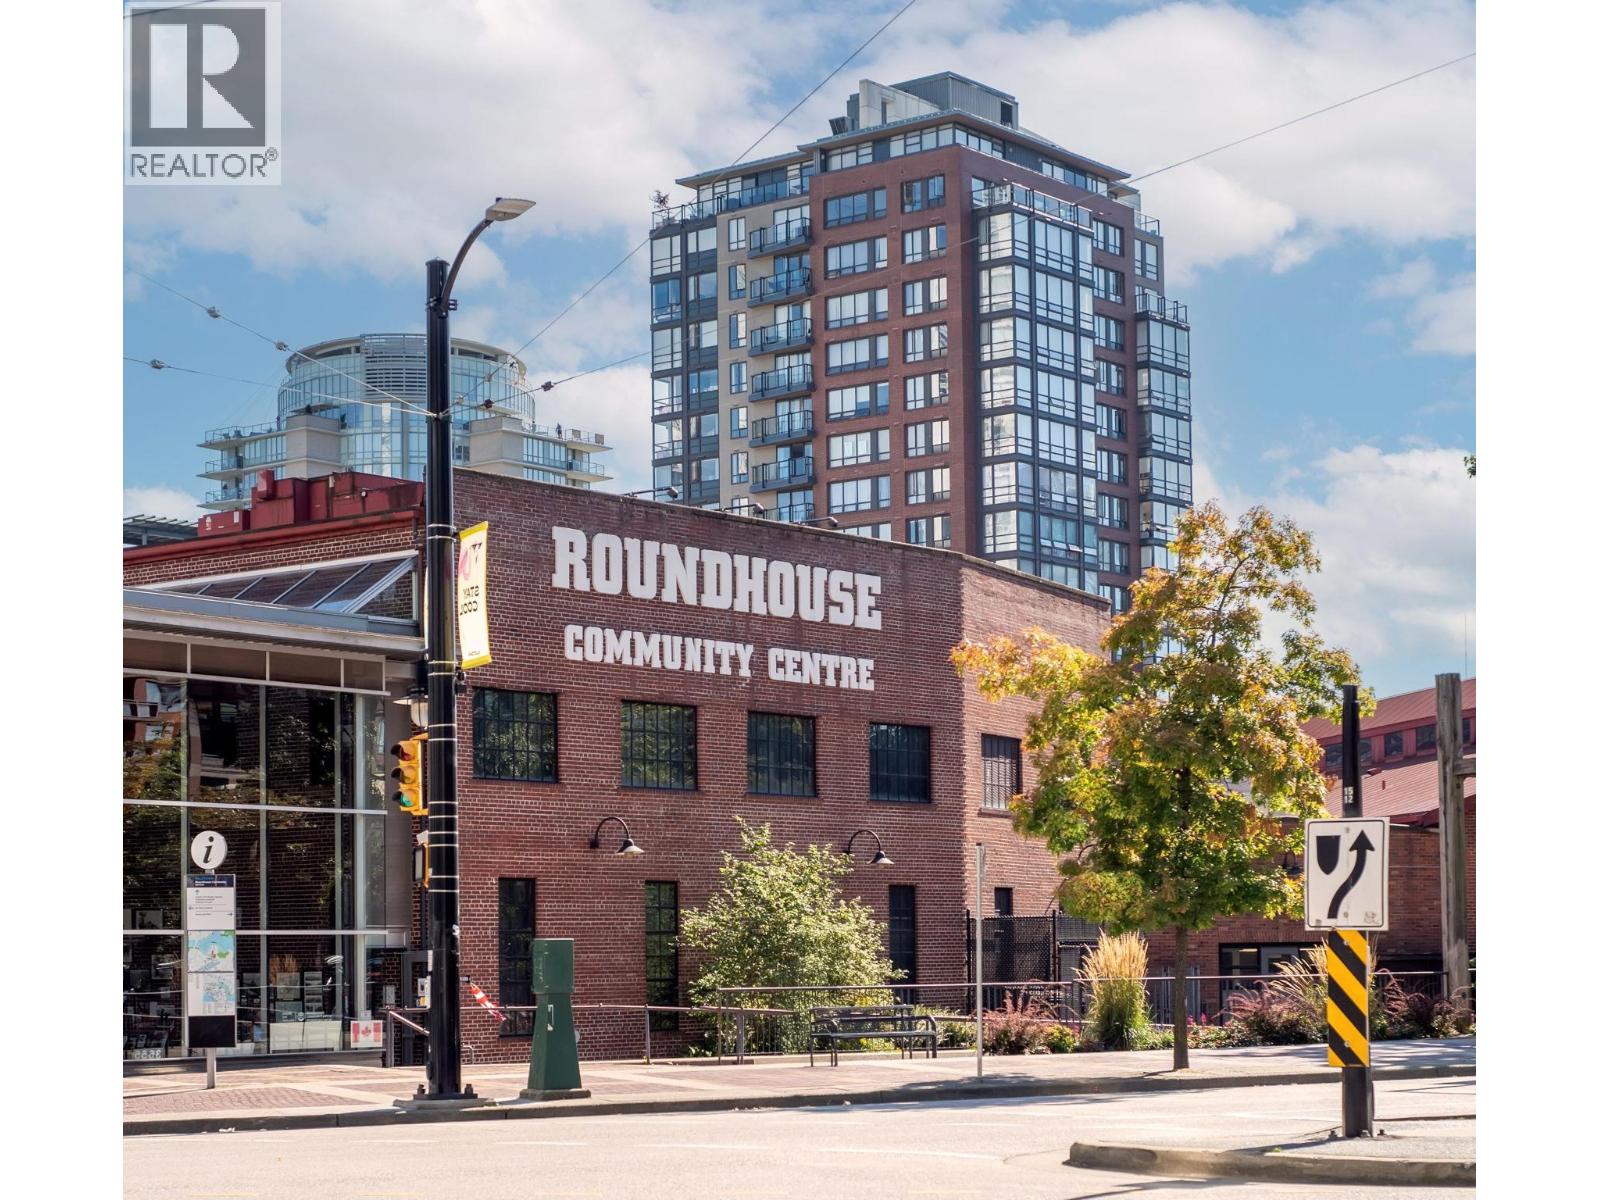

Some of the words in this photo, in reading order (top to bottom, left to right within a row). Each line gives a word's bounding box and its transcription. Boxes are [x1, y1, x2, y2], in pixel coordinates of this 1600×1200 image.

[552, 526, 882, 630] ROUNDHOUSE
[564, 624, 754, 678] COMMUNITY
[768, 648, 875, 691] CENTRE
